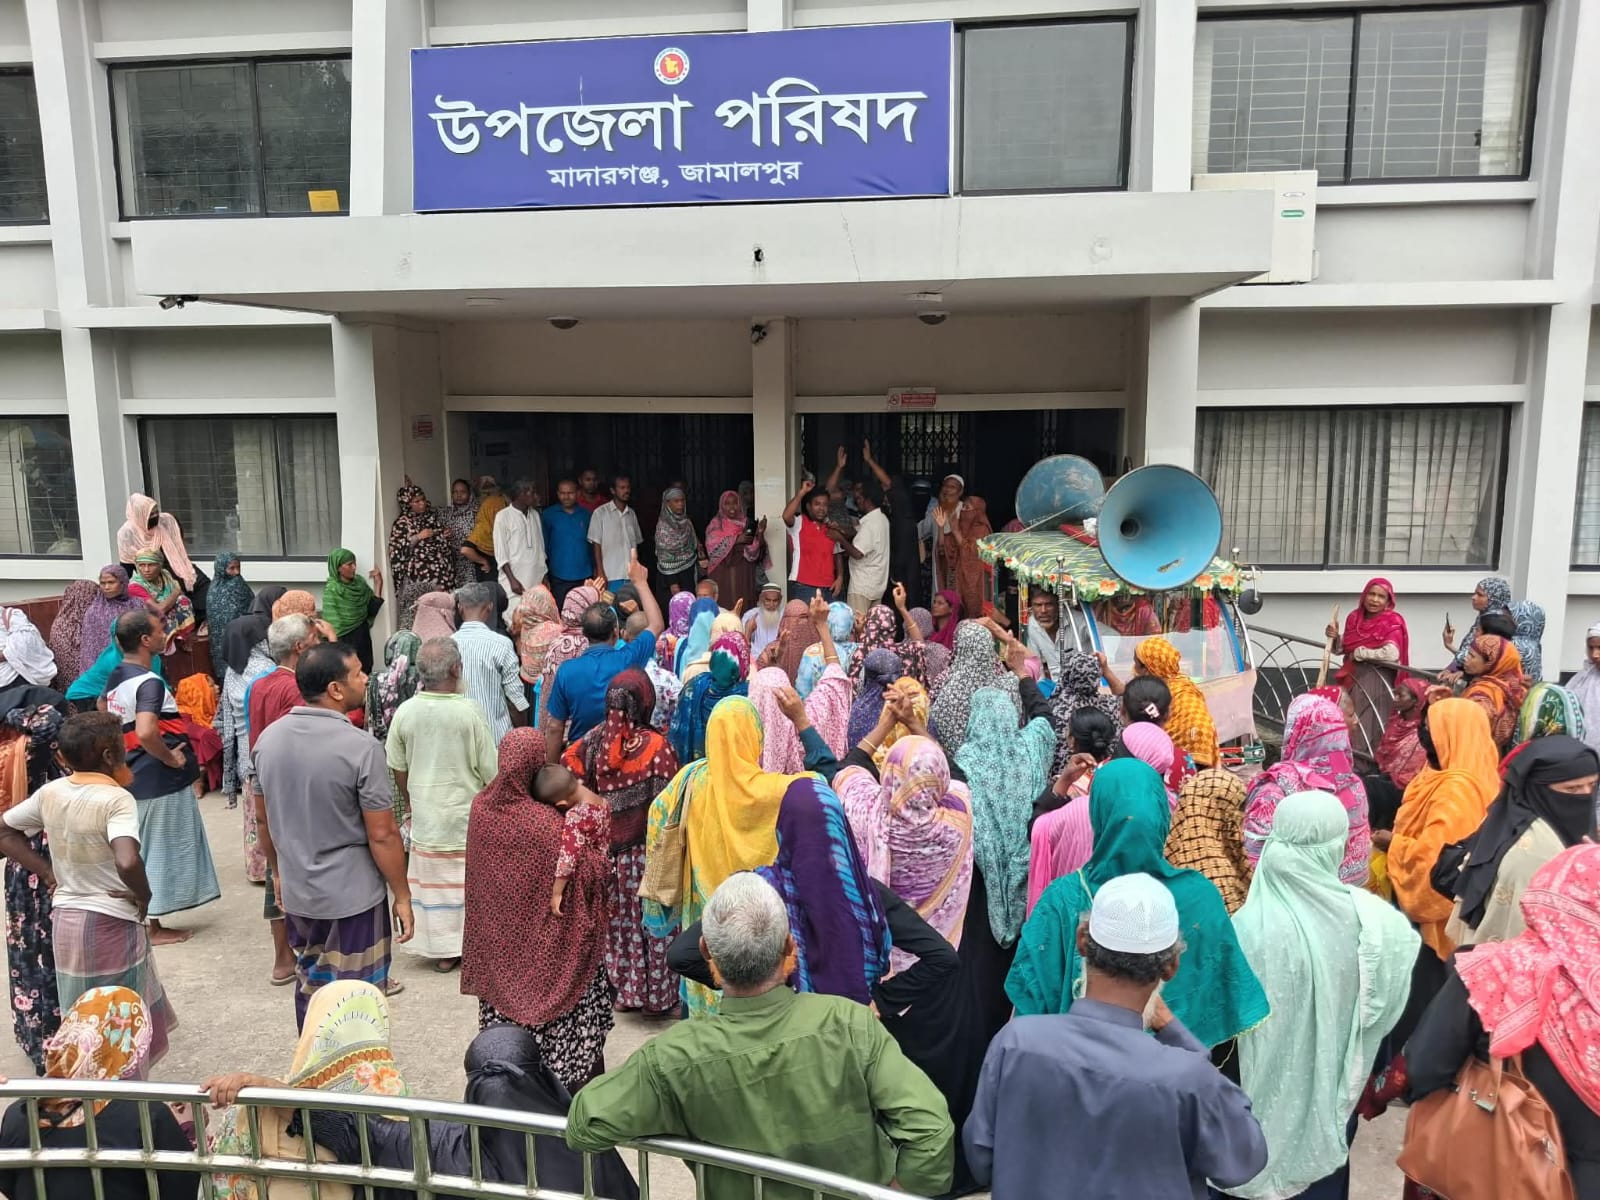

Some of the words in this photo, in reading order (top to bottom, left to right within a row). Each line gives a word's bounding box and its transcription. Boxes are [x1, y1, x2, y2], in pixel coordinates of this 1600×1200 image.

[428, 94, 695, 155] উপজেলা
[714, 77, 928, 147] পরিষদ
[546, 164, 669, 188] মাদারগঞ্জ,
[678, 160, 803, 186] জামালপুর
